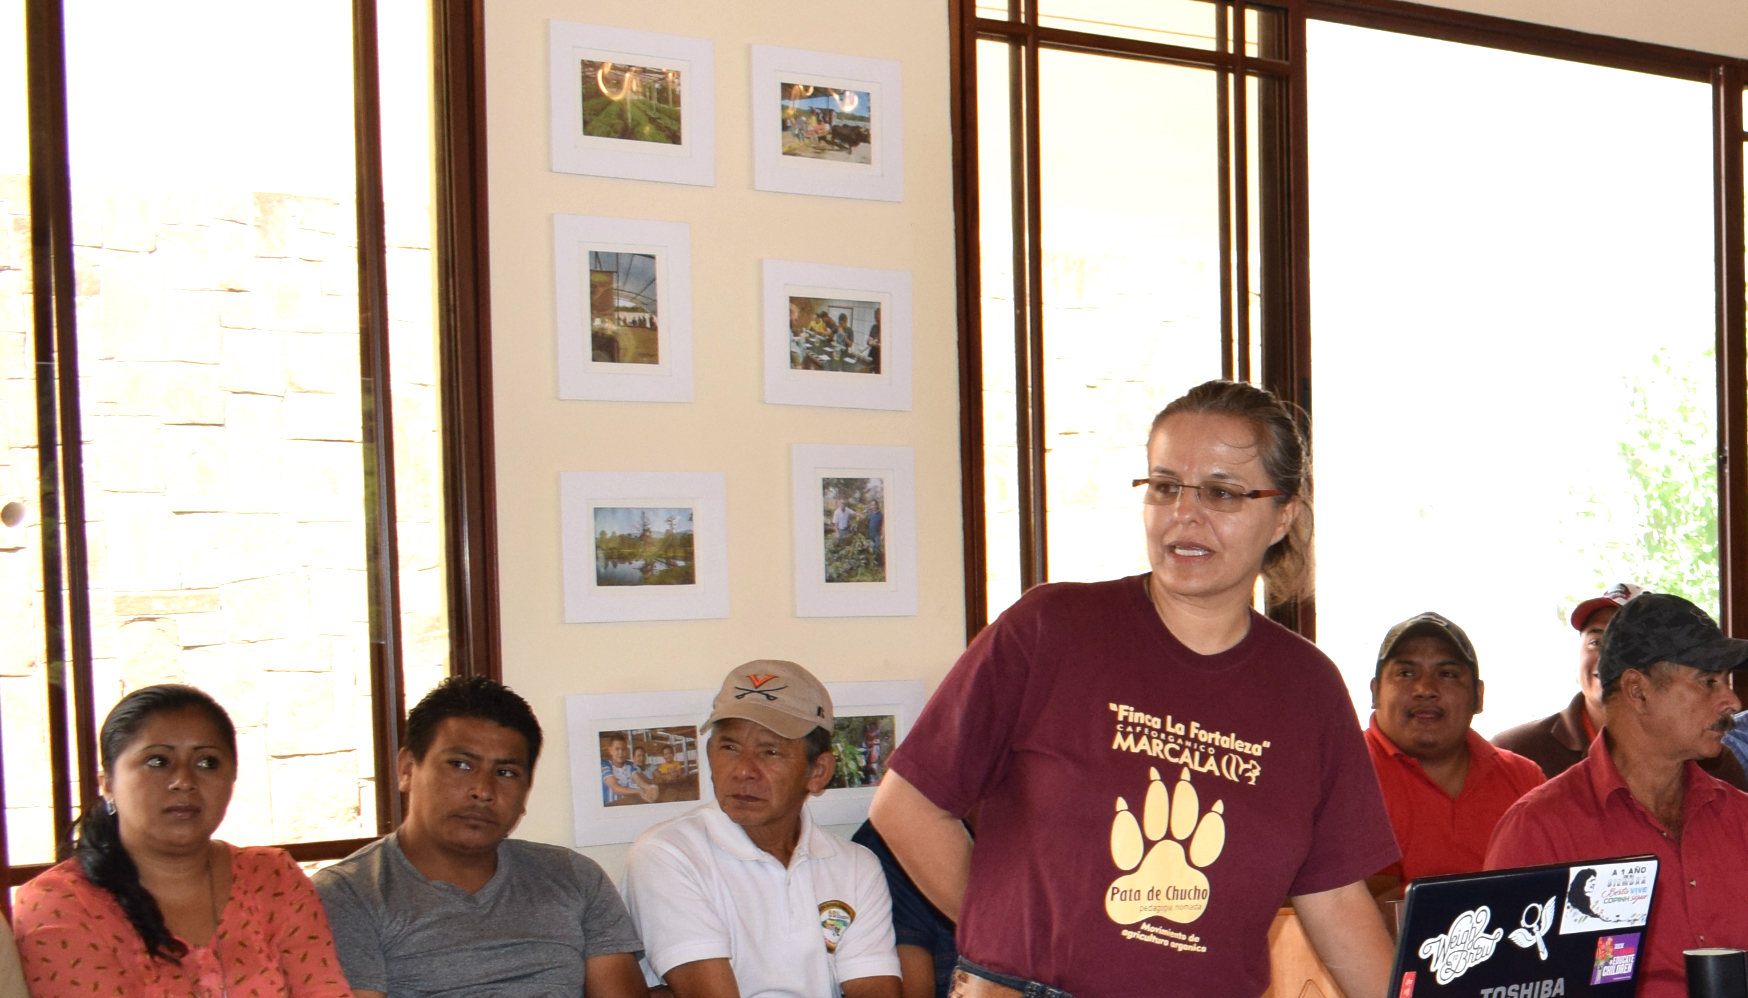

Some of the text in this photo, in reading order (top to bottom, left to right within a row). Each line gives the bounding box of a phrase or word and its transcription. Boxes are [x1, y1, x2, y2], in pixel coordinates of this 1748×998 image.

[1166, 715, 1185, 735] La
[1112, 731, 1220, 776] MARCALA
[1628, 866, 1647, 874] AÑO
[1110, 885, 1208, 901] Pata de Chucho
[1141, 922, 1186, 940] Movimiento
[1423, 909, 1488, 968] Weigh
[1440, 931, 1500, 981] Brew
[1602, 963, 1632, 976] CHILDREN
